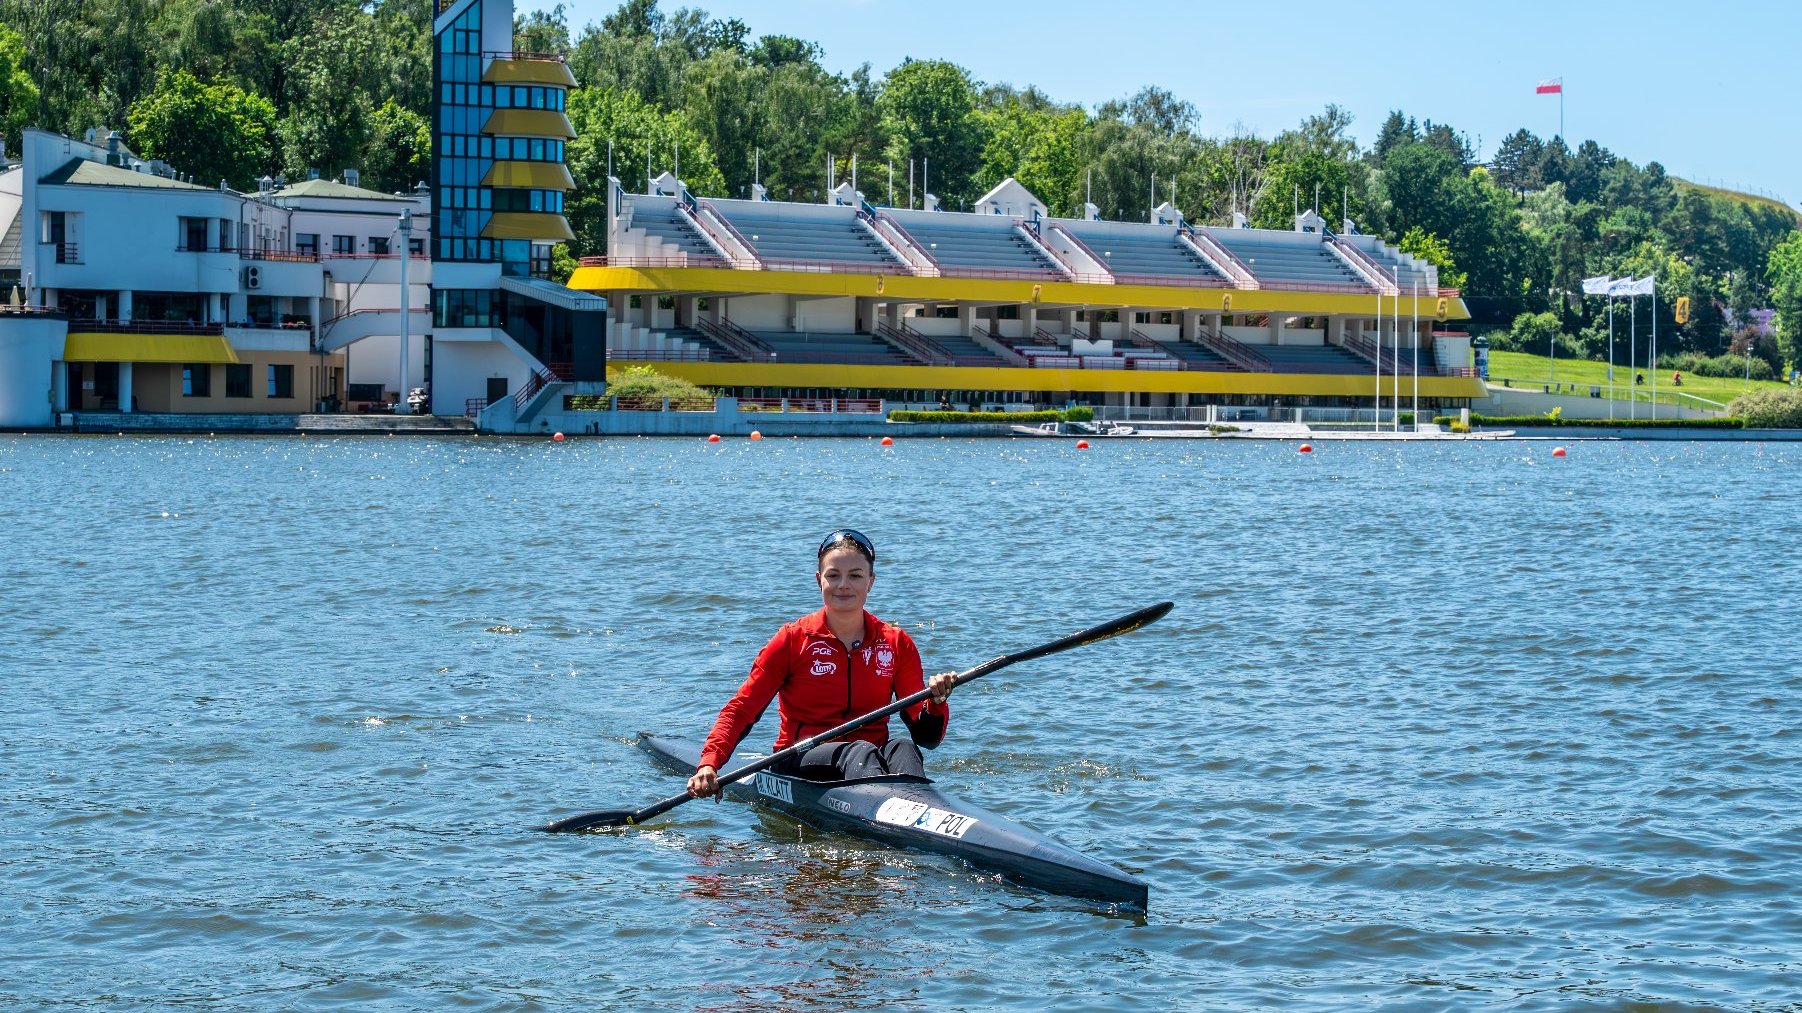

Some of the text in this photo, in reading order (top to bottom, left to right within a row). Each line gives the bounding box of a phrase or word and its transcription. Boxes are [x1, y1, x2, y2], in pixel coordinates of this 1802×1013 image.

[1439, 300, 1446, 318] 5
[1678, 300, 1687, 319] 4
[812, 647, 832, 656] PGE
[765, 775, 789, 801] KLATT
[828, 799, 850, 813] NELO
[936, 814, 968, 836] POL
